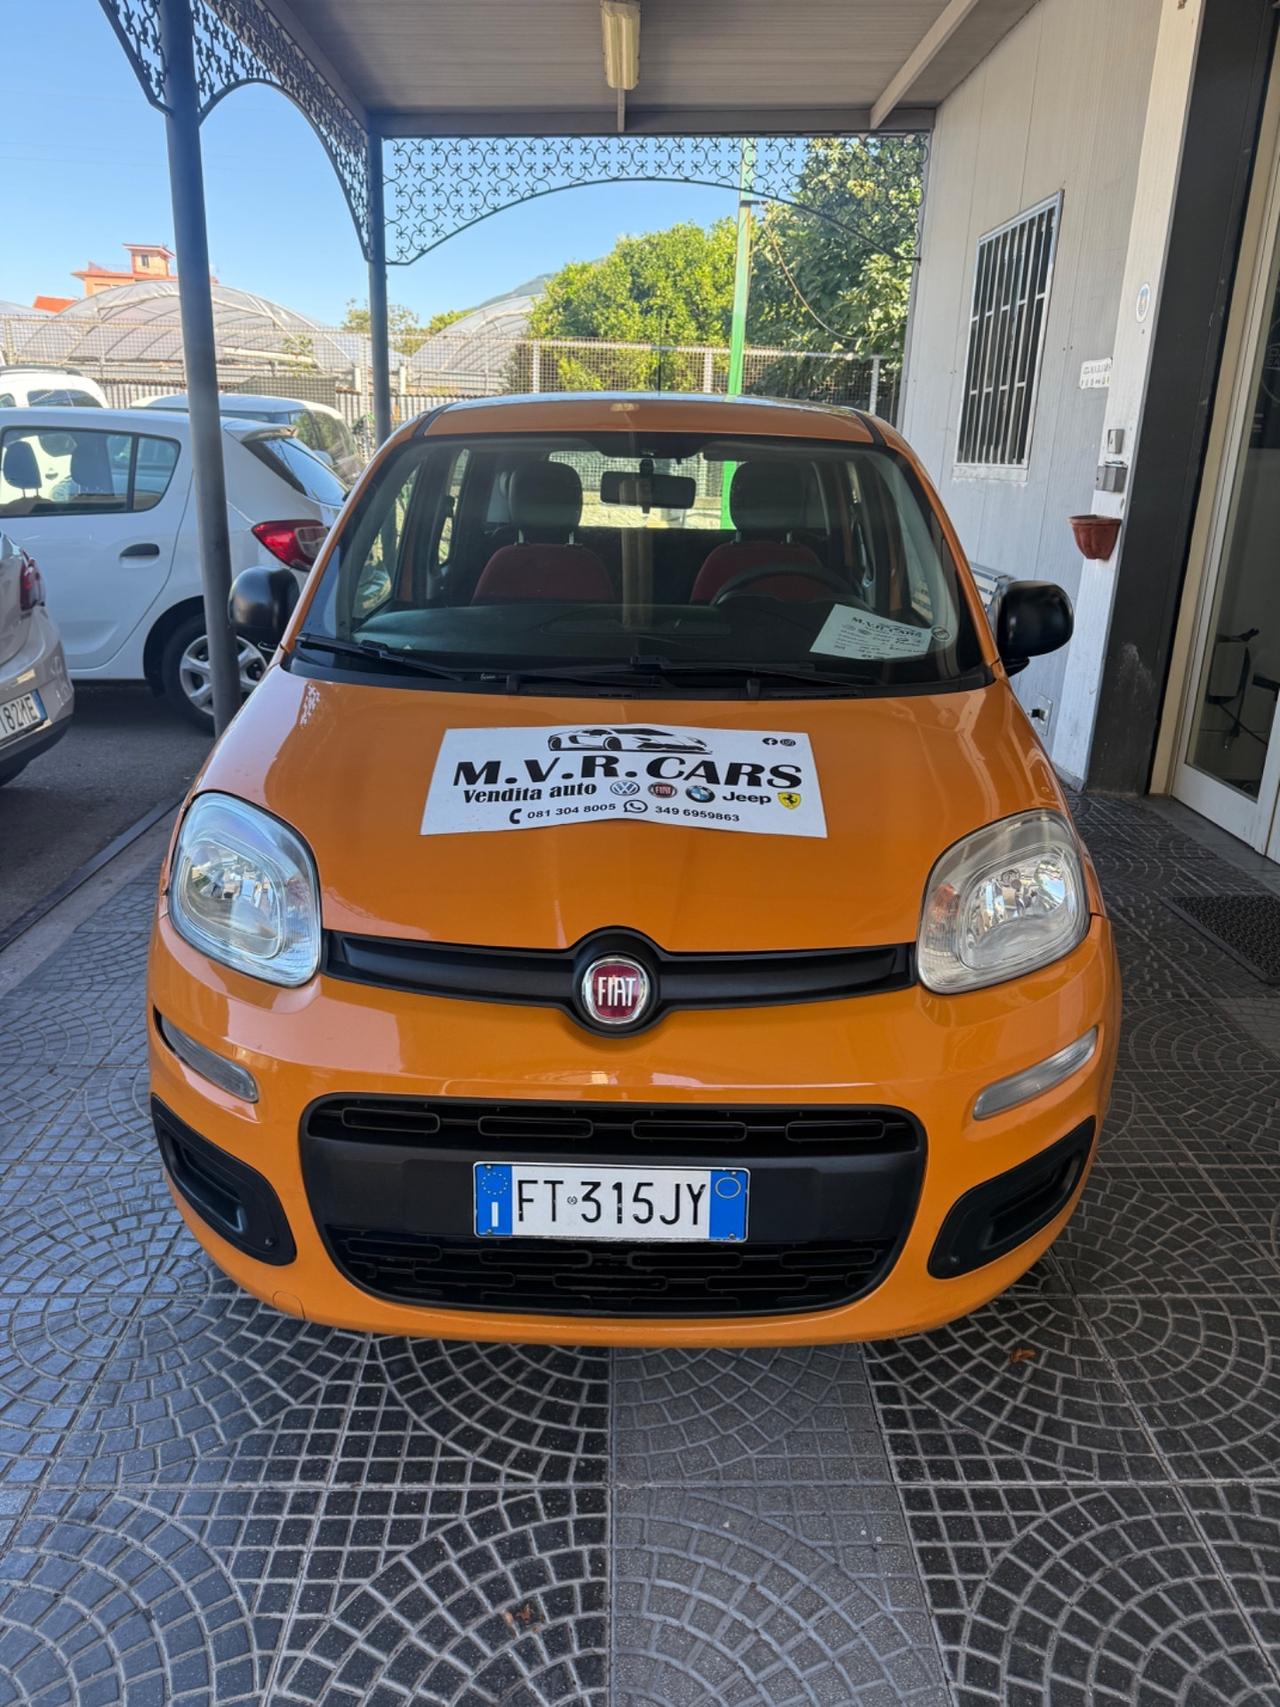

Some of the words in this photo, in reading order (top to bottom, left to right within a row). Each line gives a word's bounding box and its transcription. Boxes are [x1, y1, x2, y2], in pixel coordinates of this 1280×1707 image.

[463, 787, 542, 803] Vendita
[549, 782, 597, 799] auto
[722, 791, 772, 805] Jeep
[527, 809, 550, 819] 081
[555, 807, 579, 816] 304
[583, 803, 616, 813] 8005
[655, 805, 680, 816] 349
[683, 808, 740, 822] 6959863
[598, 975, 637, 1007] FIAT
